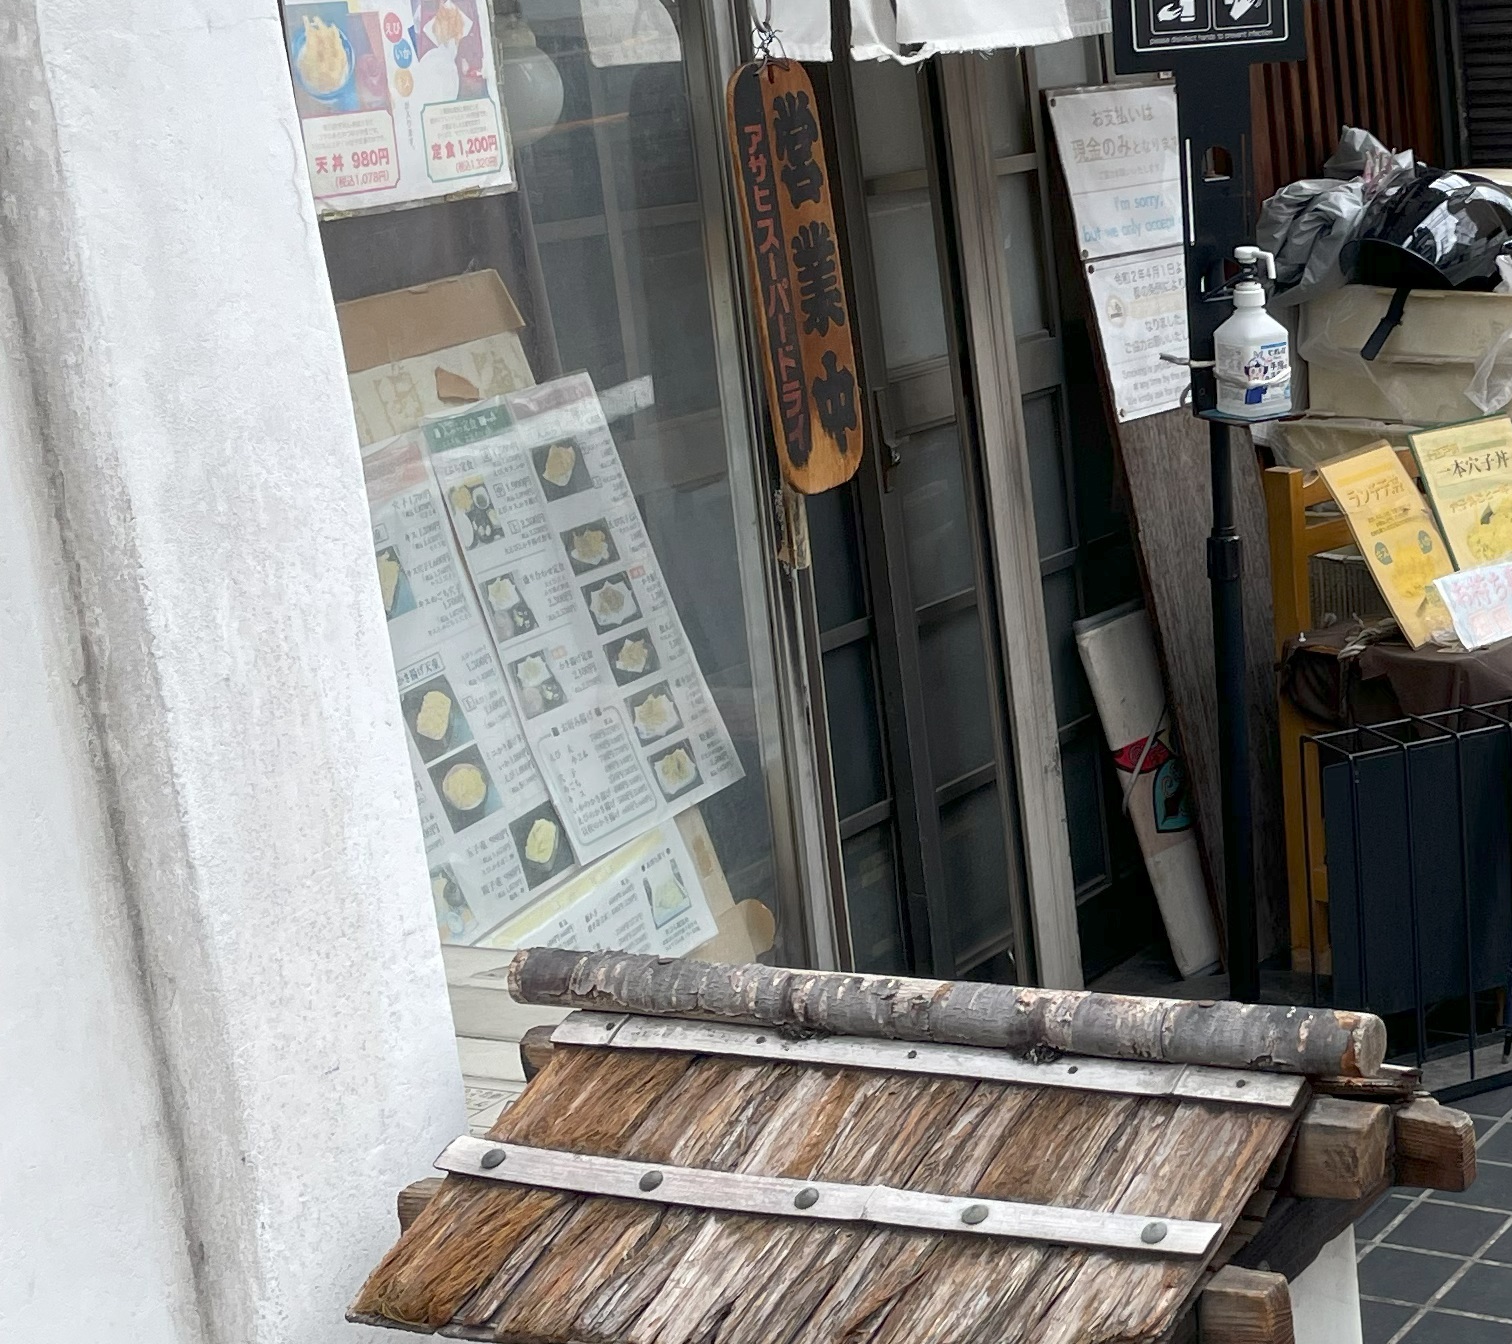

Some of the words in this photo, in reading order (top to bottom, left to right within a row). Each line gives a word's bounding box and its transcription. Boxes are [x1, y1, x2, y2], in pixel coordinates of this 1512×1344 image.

[395, 49, 411, 62] いか
[1091, 104, 1154, 127] お支払いは
[315, 153, 344, 174] 天丼
[352, 147, 390, 169] 980円
[431, 141, 456, 160] 定食
[458, 134, 498, 157] 1,200円
[1113, 196, 1131, 212] I'm
[1134, 194, 1164, 210] sorry,
[1082, 224, 1102, 243] but
[1105, 227, 1119, 238] we
[1121, 217, 1141, 237] only
[1145, 215, 1175, 233] accept
[772, 90, 857, 454] 営業中
[742, 124, 806, 451] アサヒスーパードライ
[1436, 449, 1510, 479] 一本穴子丼
